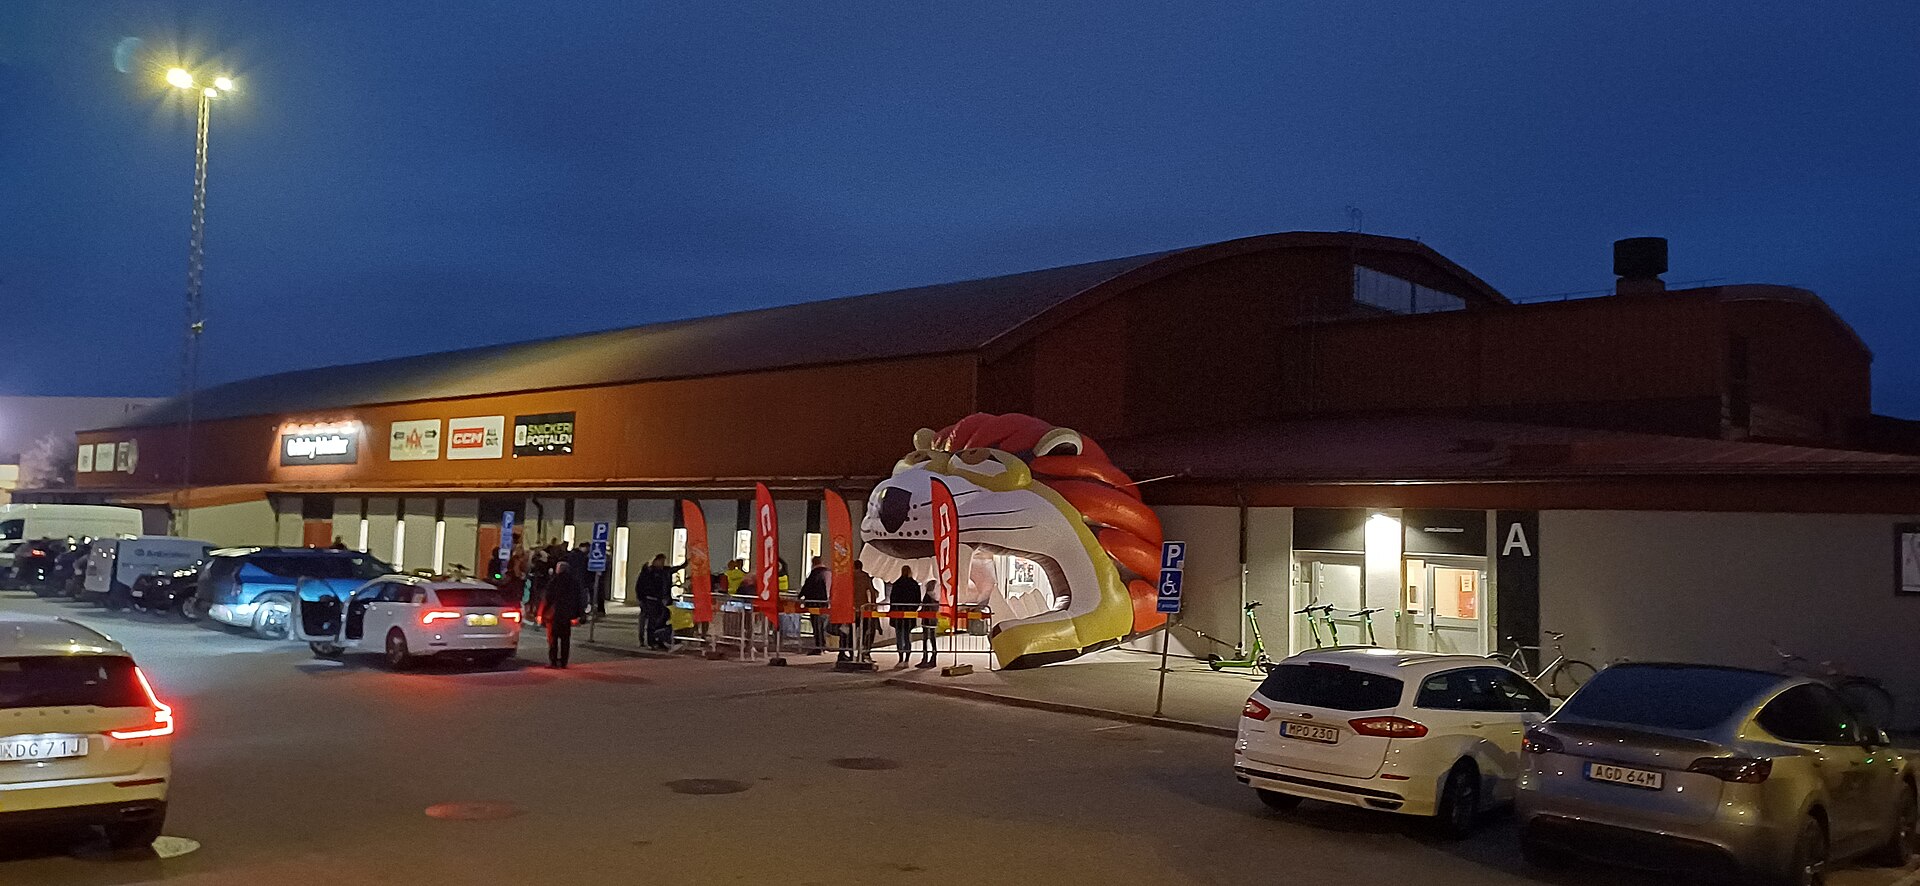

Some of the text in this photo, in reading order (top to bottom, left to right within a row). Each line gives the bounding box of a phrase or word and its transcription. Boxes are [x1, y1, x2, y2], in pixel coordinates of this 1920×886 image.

[453, 432, 483, 445] CCM
[527, 433, 573, 446] PORTALEN
[596, 523, 606, 539] P
[1502, 522, 1531, 557] A
[940, 503, 954, 607] CCM
[1167, 544, 1181, 567] P
[1289, 723, 1334, 740] MPO 230
[5, 739, 80, 758] XDG 71J
[1595, 765, 1656, 785] AGD 64M
